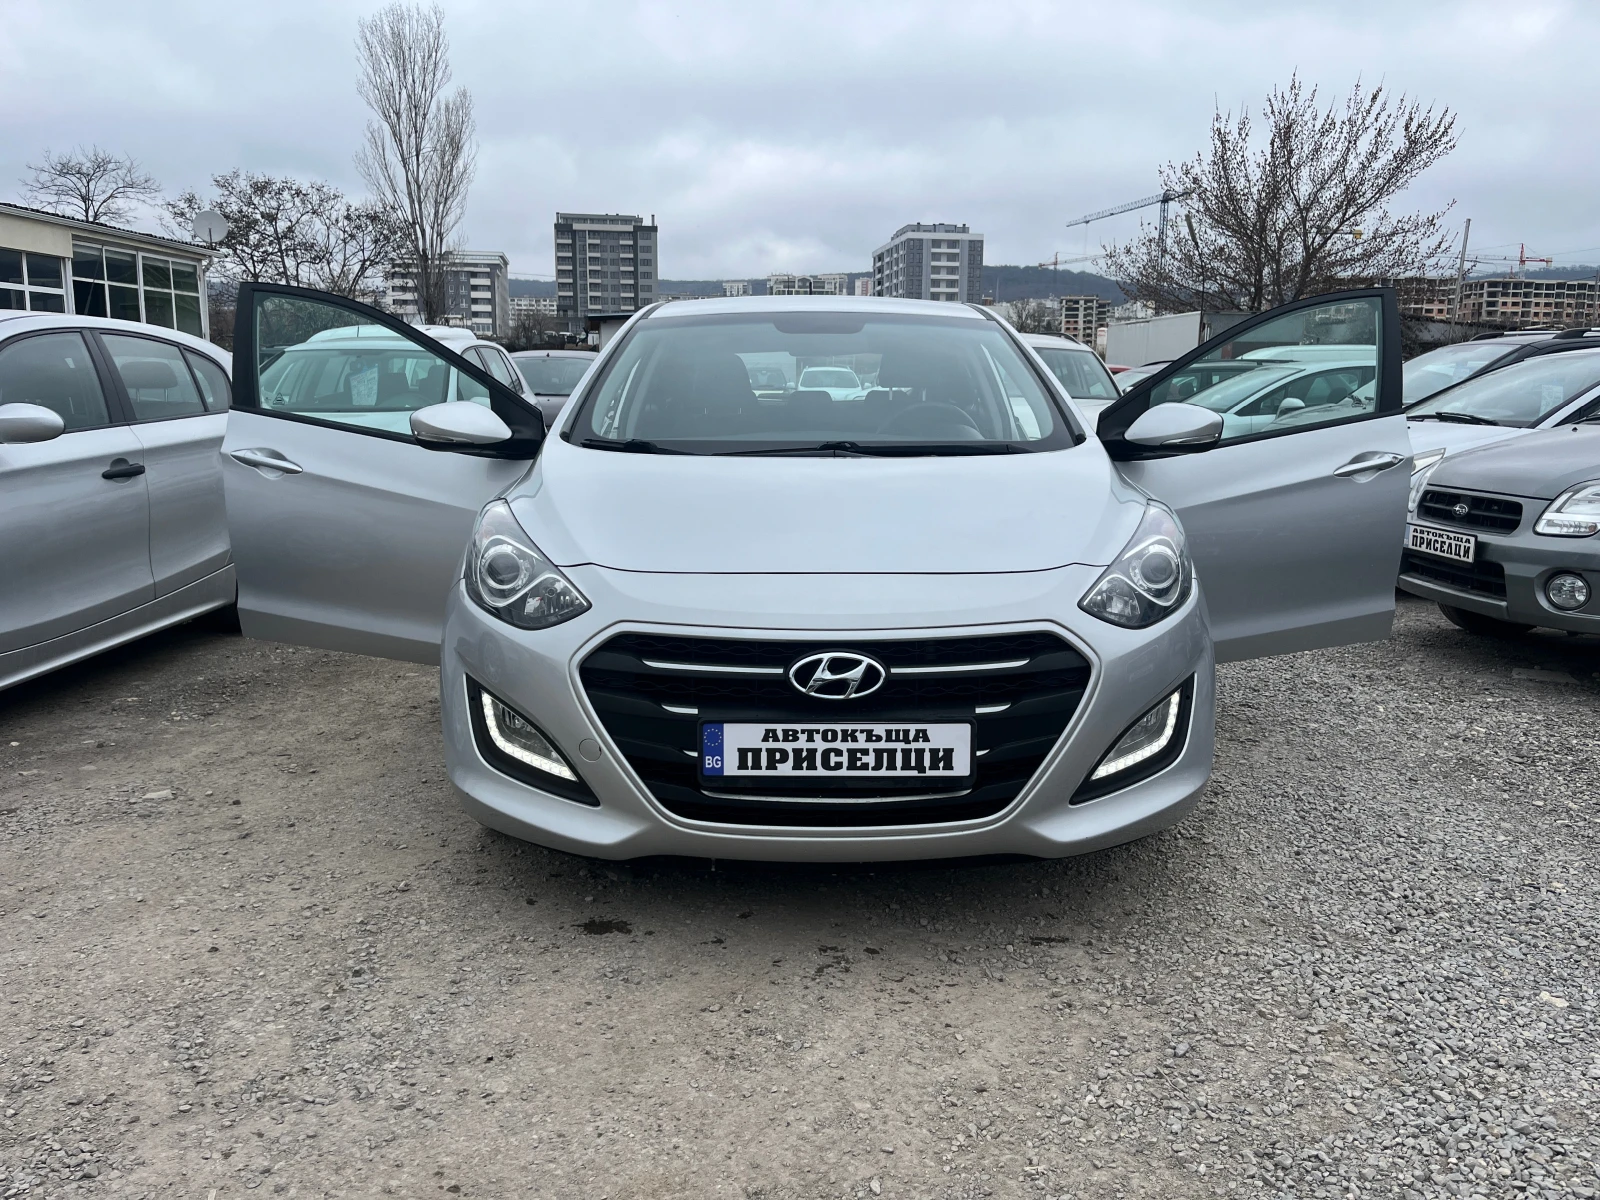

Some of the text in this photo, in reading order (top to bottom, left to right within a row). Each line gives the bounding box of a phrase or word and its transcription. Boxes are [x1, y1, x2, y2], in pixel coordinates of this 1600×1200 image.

[1412, 528, 1471, 544] АВТОКЪЩА
[1411, 534, 1471, 559] ПРИСЕЛЦИ
[761, 728, 931, 745] АВТОКЪЩА
[705, 756, 722, 768] BG
[737, 747, 955, 774] ПРИСЕЛЦИ
